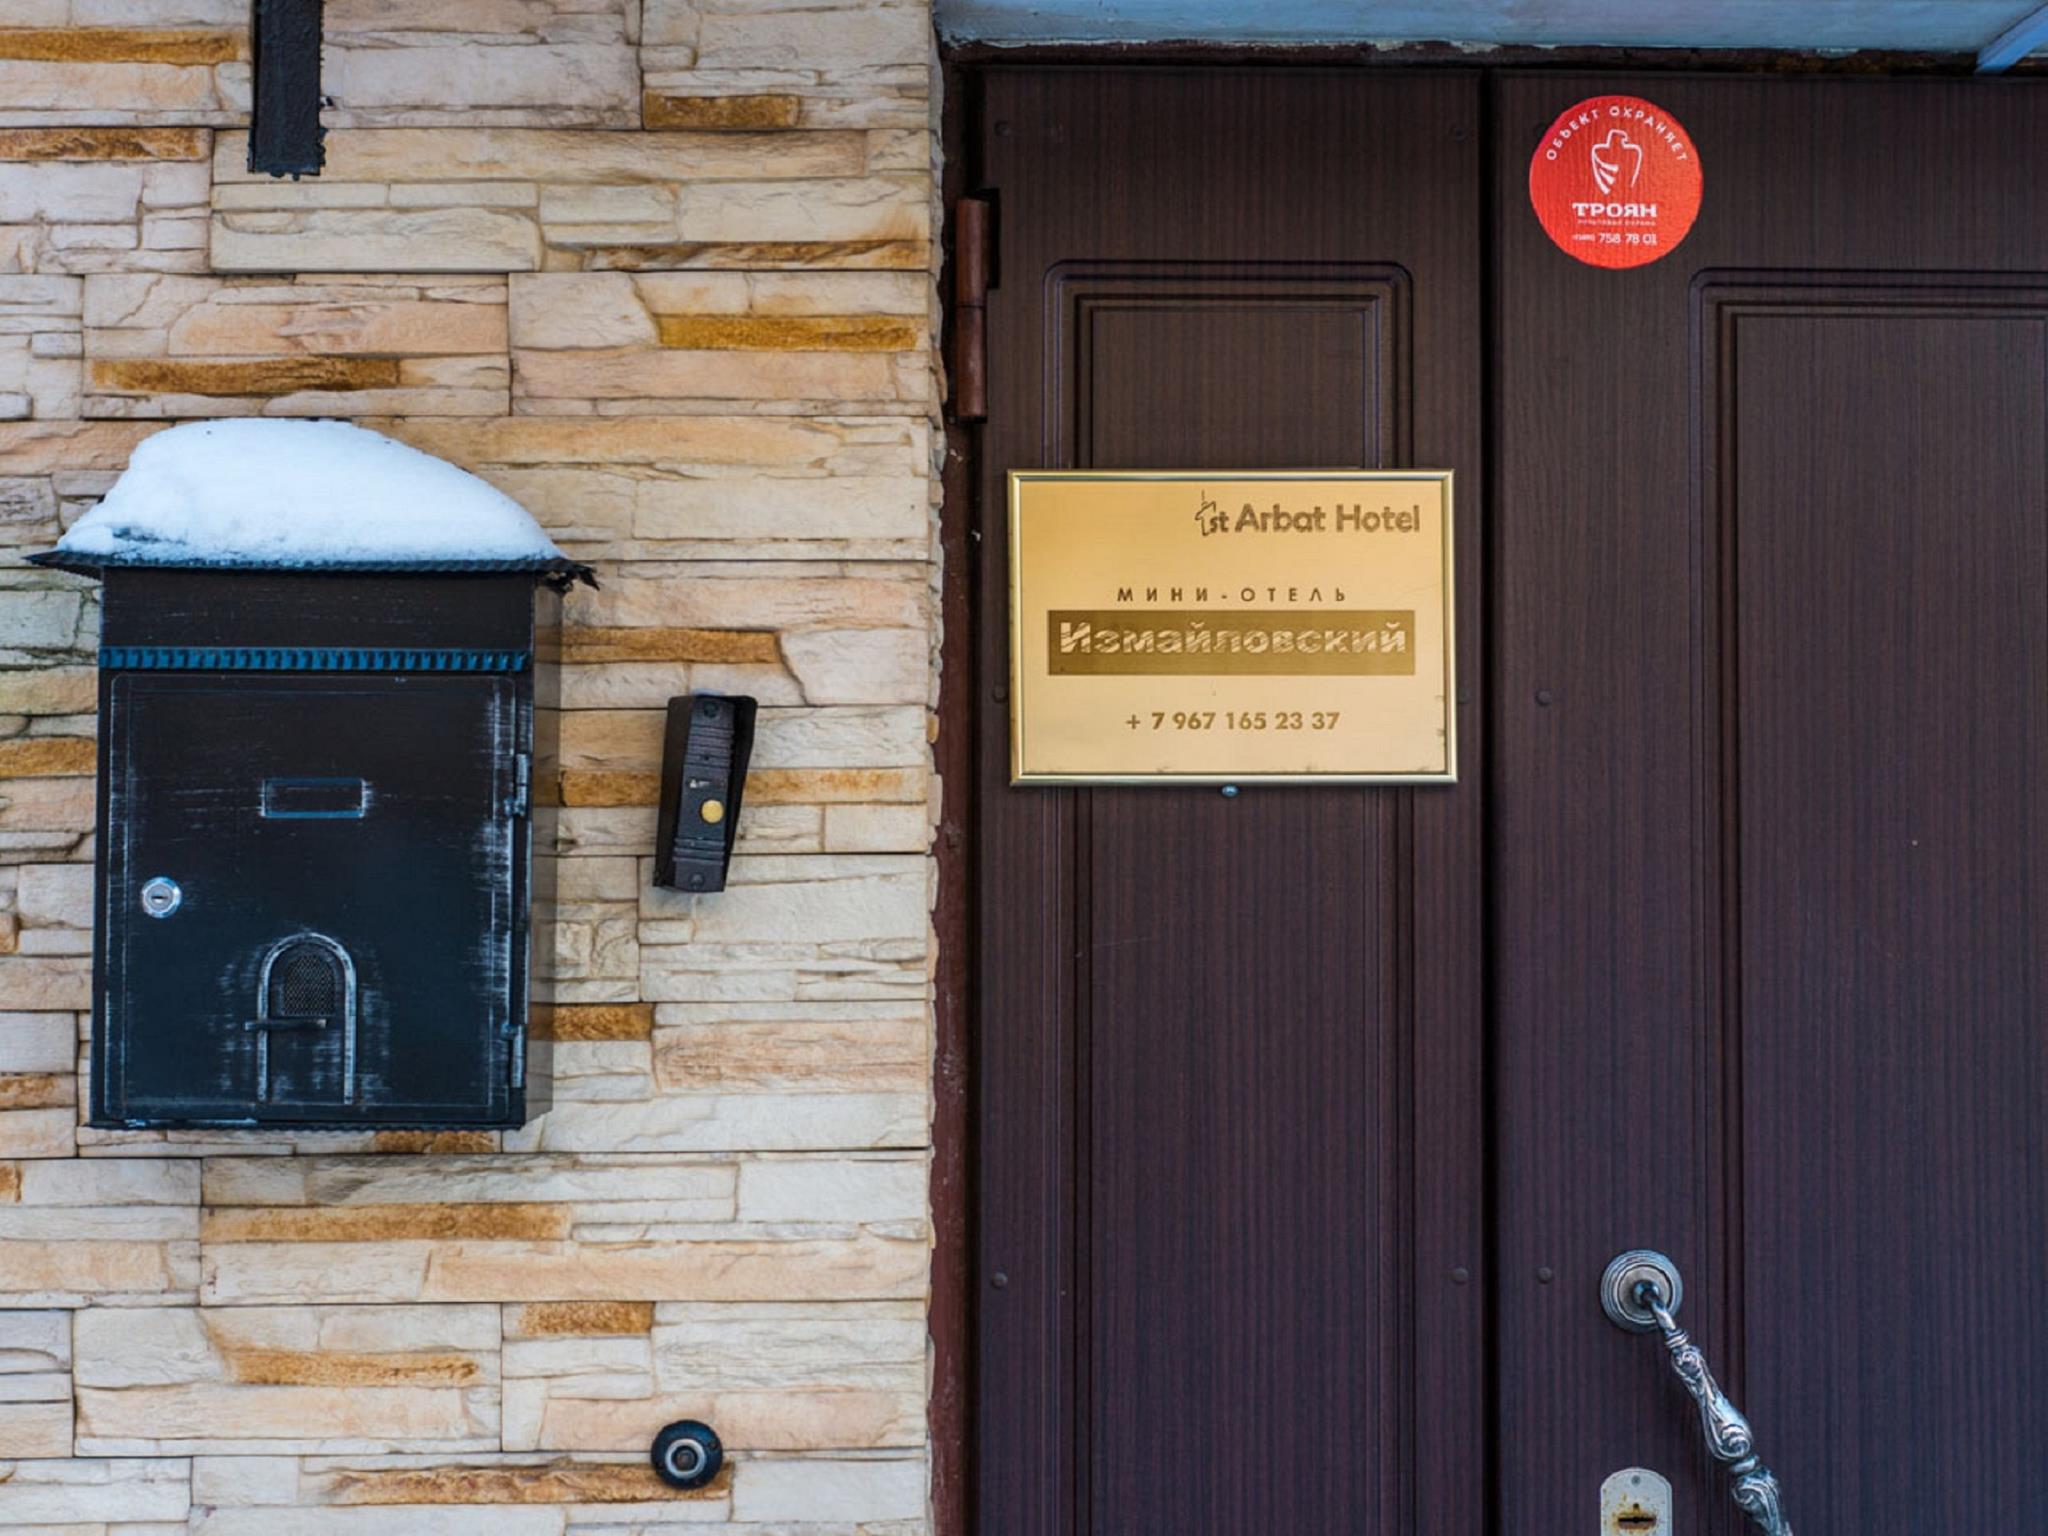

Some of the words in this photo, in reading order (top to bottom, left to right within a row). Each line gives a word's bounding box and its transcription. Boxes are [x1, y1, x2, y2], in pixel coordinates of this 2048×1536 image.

[1609, 105, 1688, 161] ОХРАНЯЕТ
[1571, 202, 1658, 218] ТРОЯН
[1235, 503, 1326, 533] Arbat
[1336, 503, 1421, 533] Hotel
[1060, 621, 1407, 654] Измайловский
[1152, 712, 1165, 730] 7
[1172, 712, 1216, 730] 967
[1225, 712, 1267, 730] 165
[1274, 712, 1303, 730] 23
[1311, 712, 1341, 730] 37
